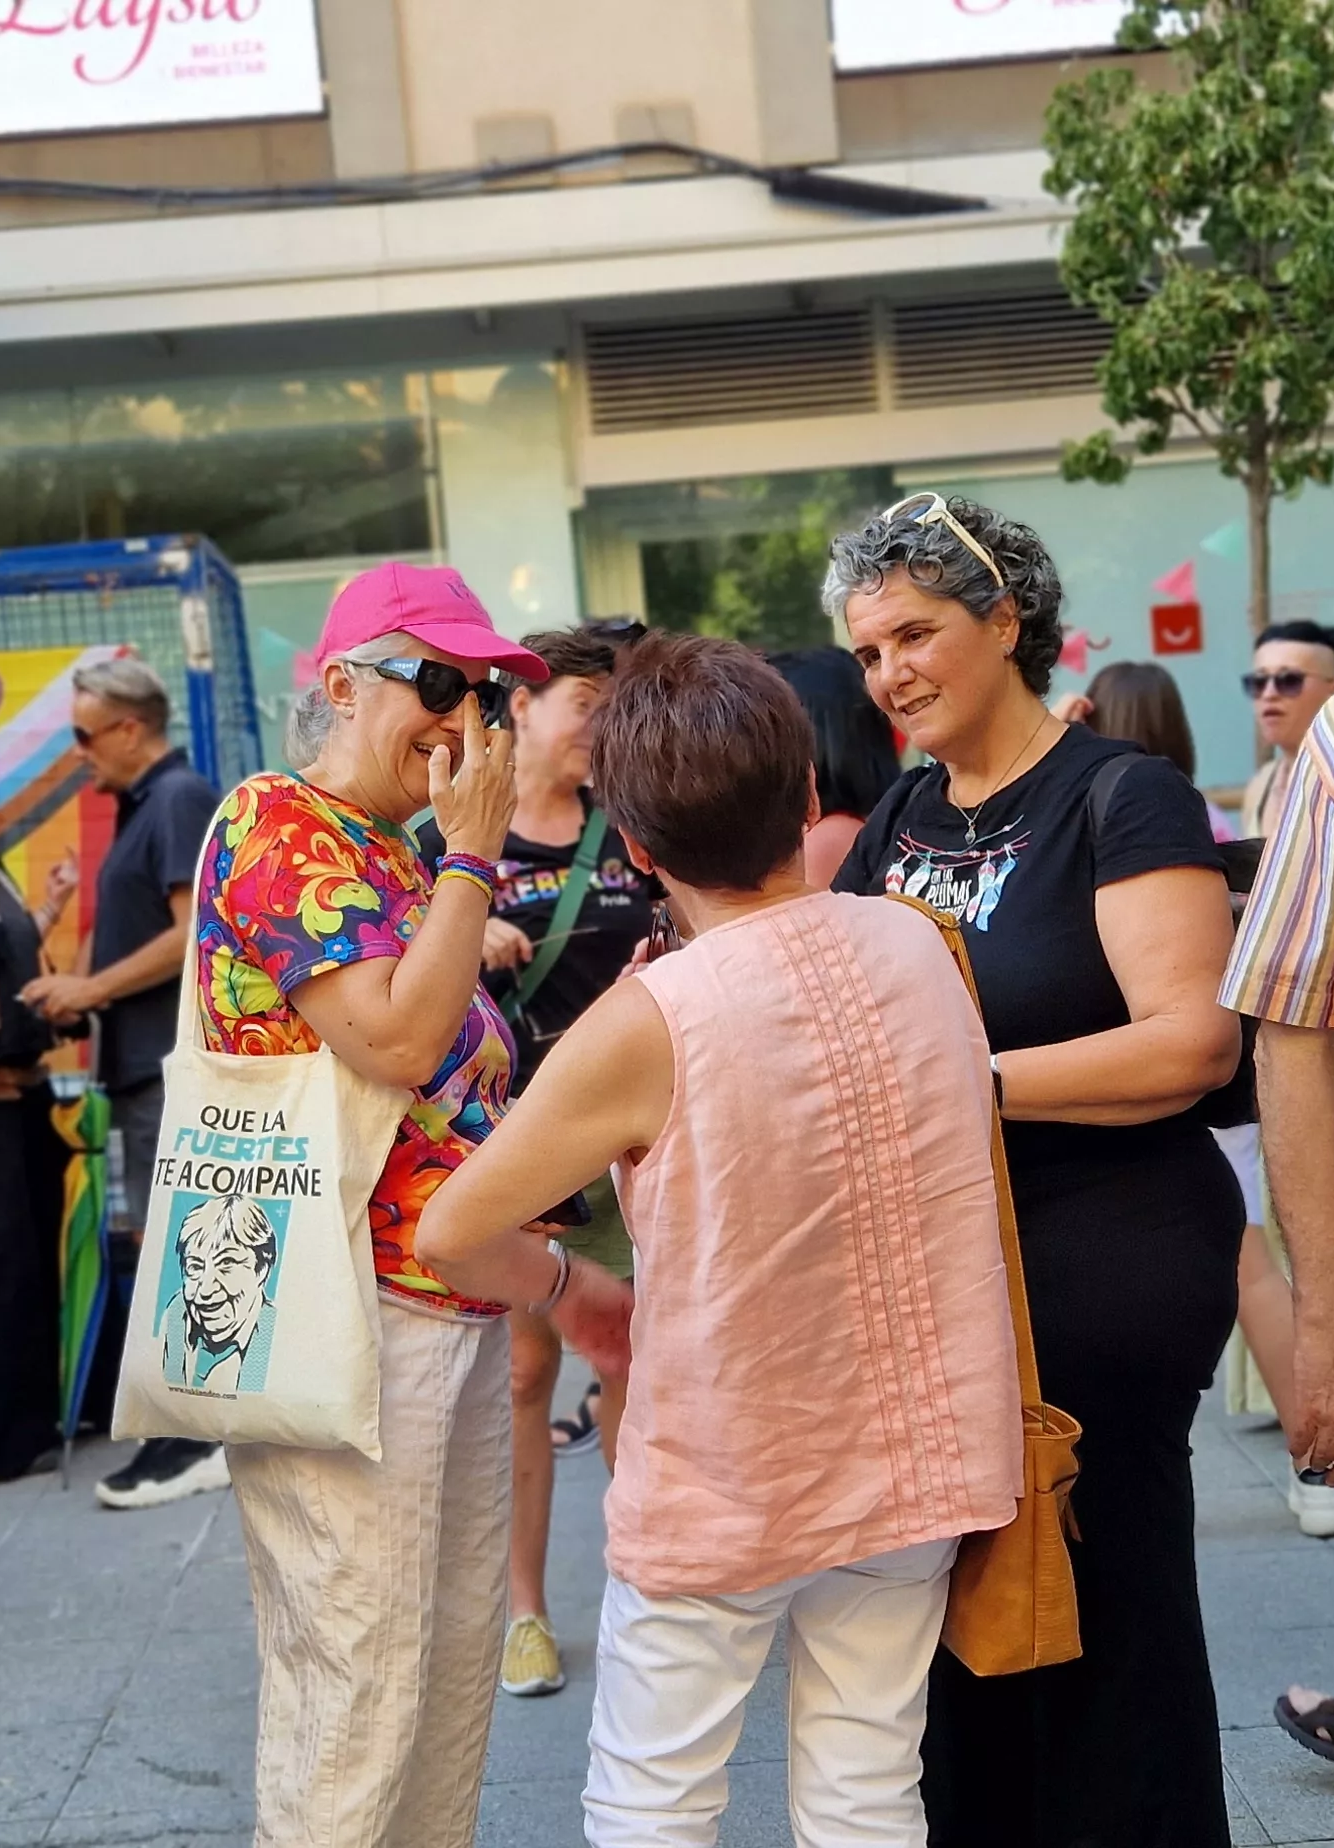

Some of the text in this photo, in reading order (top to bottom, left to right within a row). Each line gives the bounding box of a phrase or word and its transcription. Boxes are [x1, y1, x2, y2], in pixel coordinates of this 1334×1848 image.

[925, 879, 973, 911] PLUMAS
[200, 1104, 286, 1132] QUE LA
[173, 1127, 310, 1162] FUERTES
[155, 1158, 322, 1197] TE ACOMPAÑE
